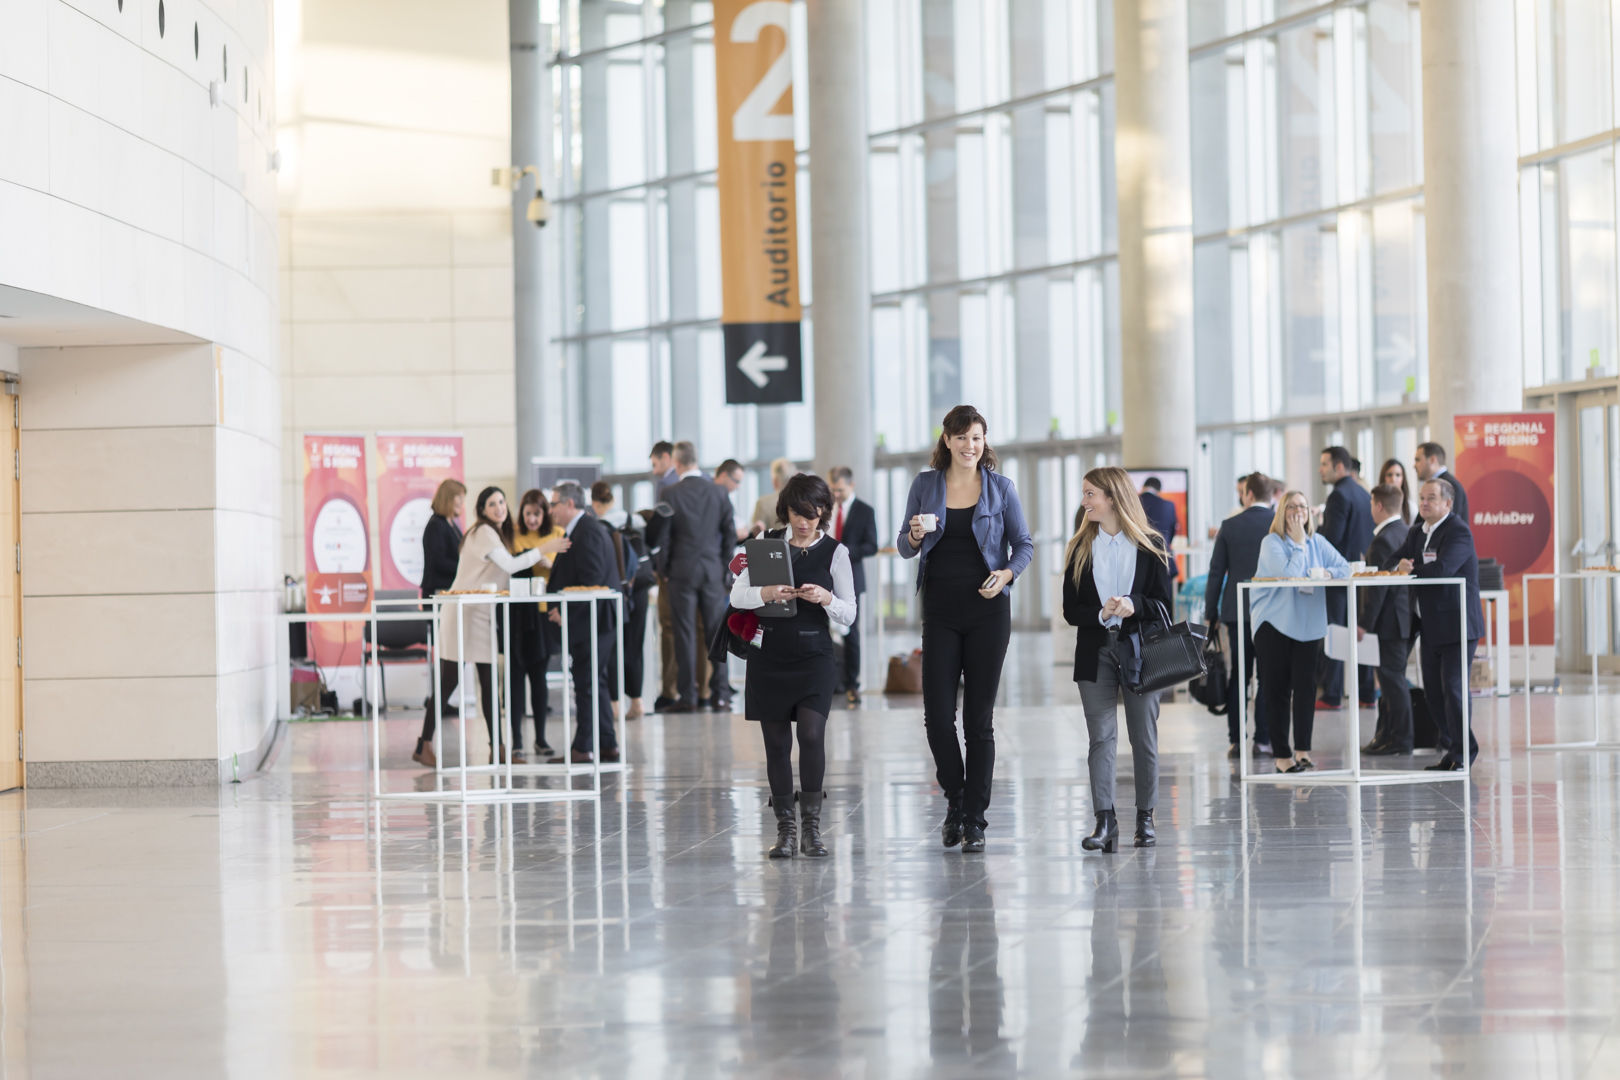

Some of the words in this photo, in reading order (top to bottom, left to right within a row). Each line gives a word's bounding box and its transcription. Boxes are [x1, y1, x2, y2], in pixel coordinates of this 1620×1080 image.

[730, 0, 794, 142] 2
[761, 160, 790, 308] Auditorio
[1484, 422, 1546, 434] REGIONAL
[1484, 435, 1497, 447] IS
[1498, 434, 1539, 446] RISING
[1474, 510, 1535, 525] #AviaDev
